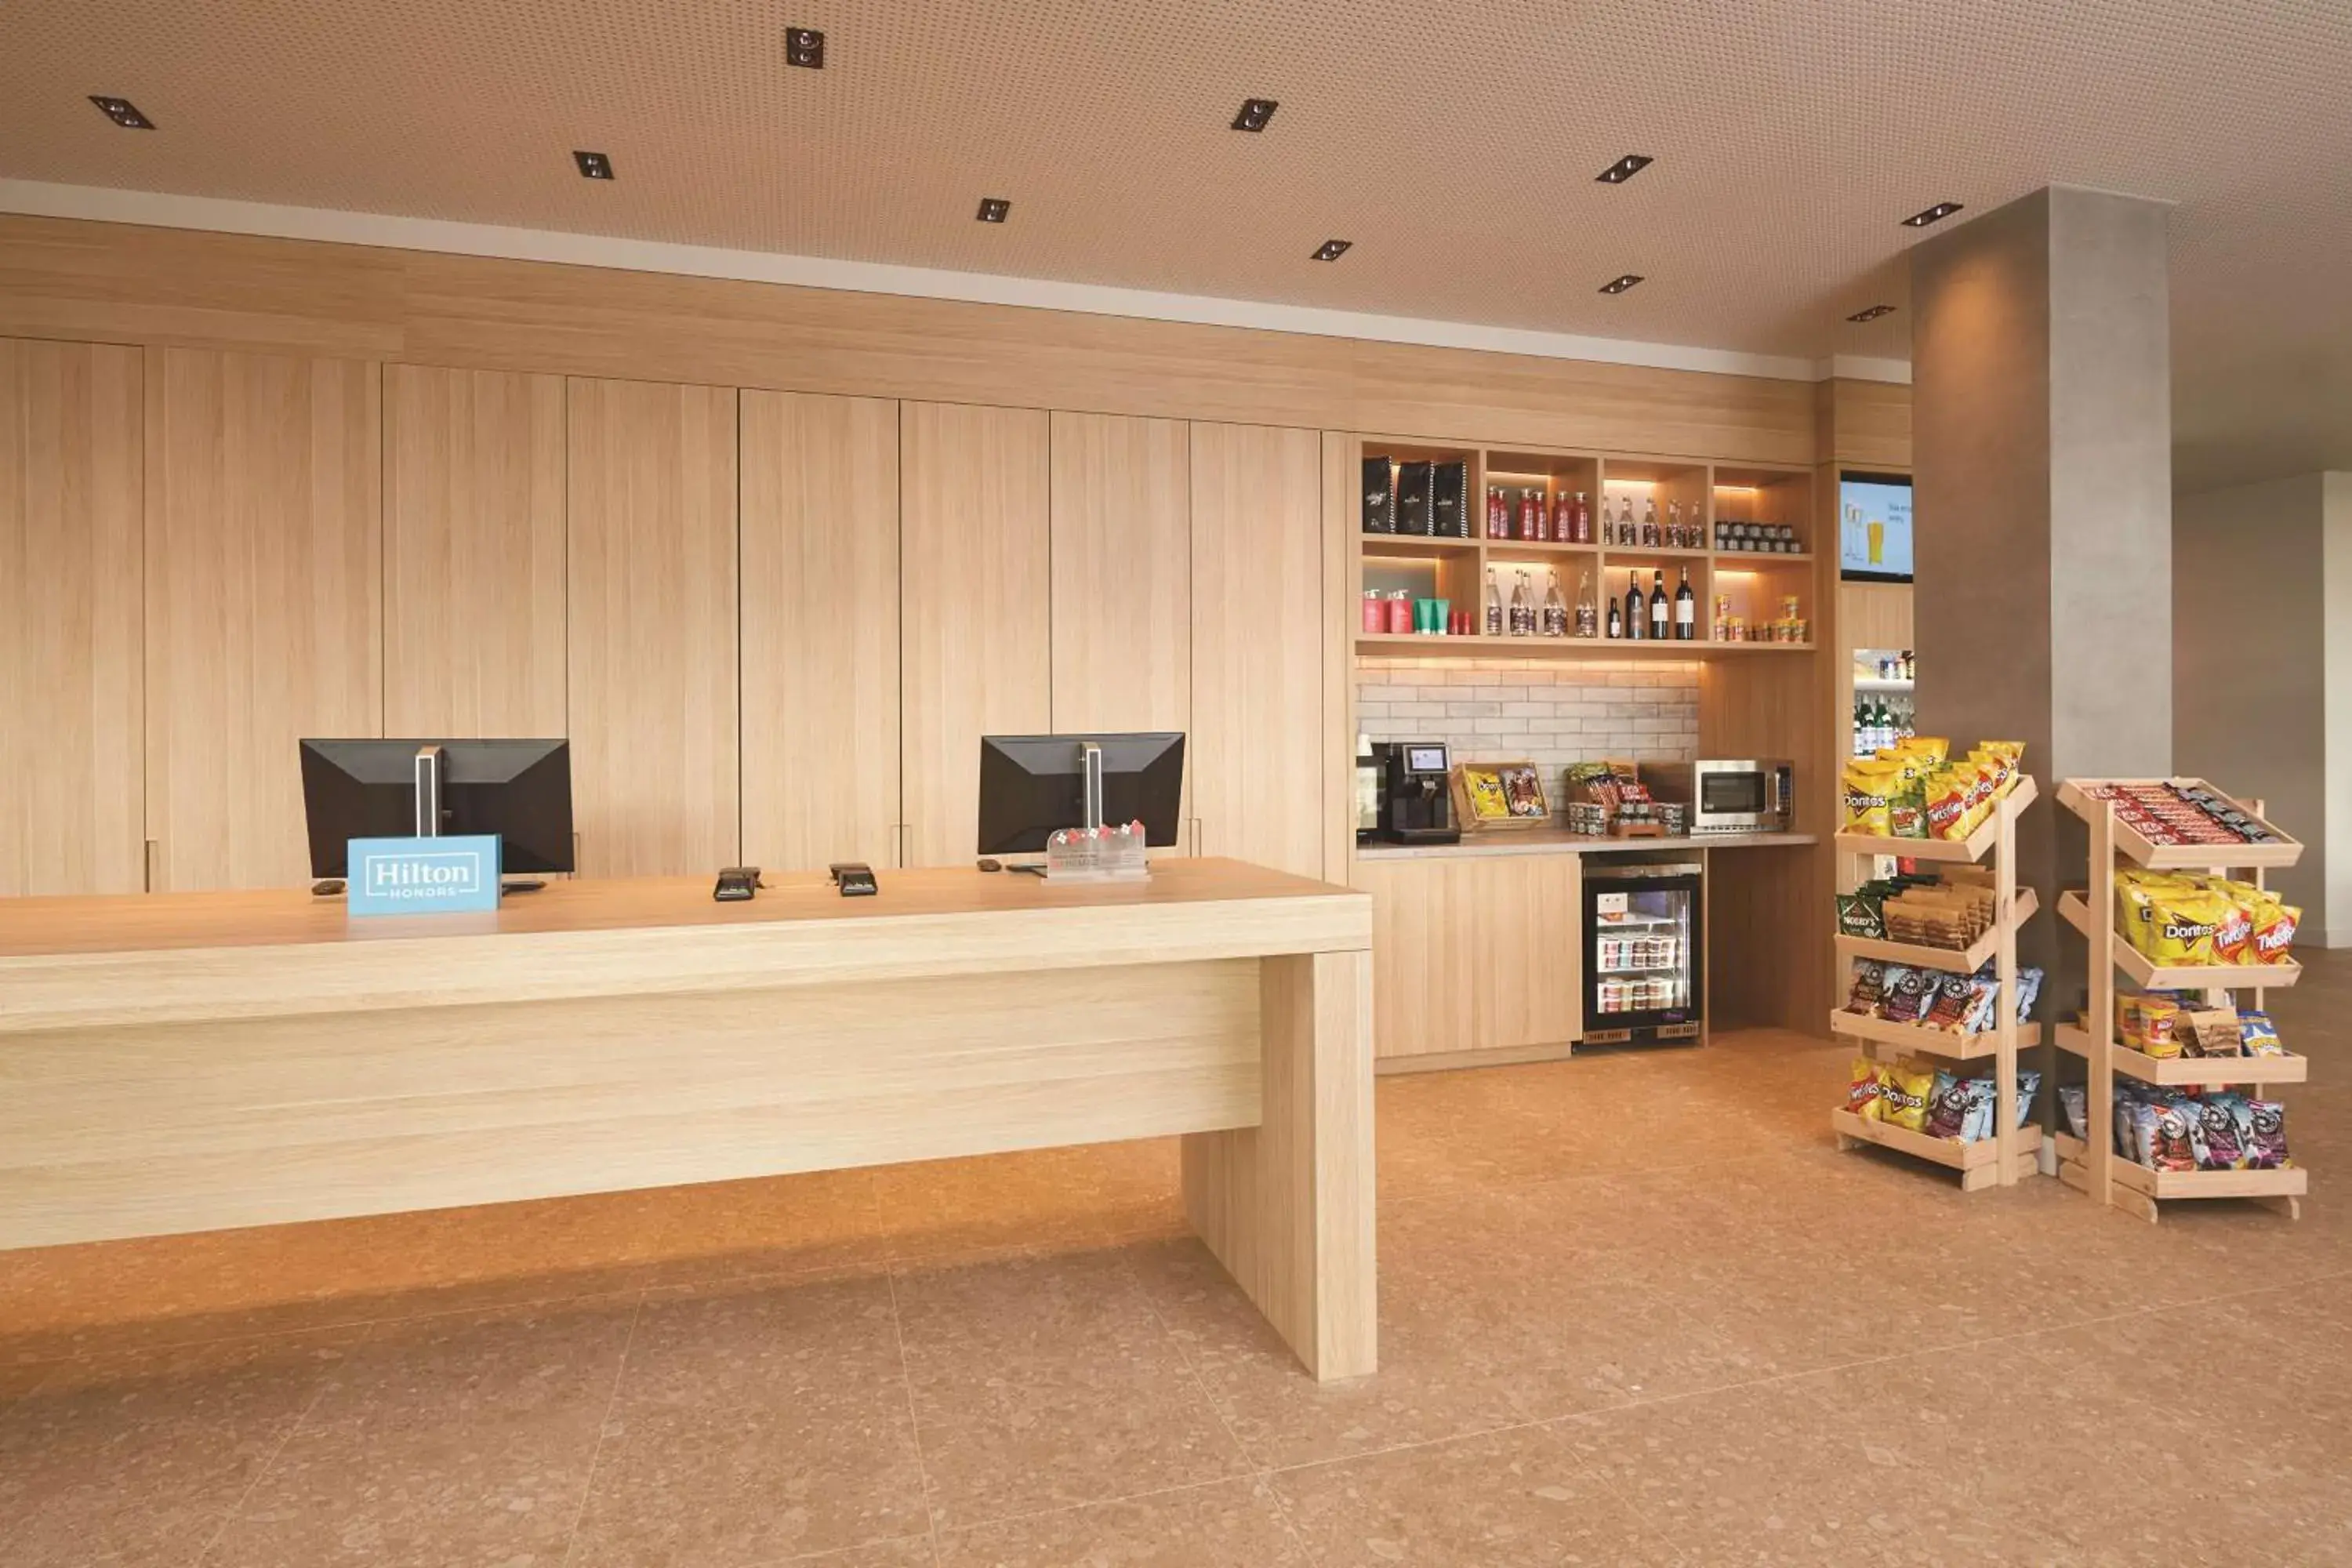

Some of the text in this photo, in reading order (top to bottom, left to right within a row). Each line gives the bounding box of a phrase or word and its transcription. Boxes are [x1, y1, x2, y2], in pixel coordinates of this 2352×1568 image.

[376, 863, 470, 886] Hilton
[390, 887, 456, 898] HONORS
[2166, 925, 2214, 938] Doritos
